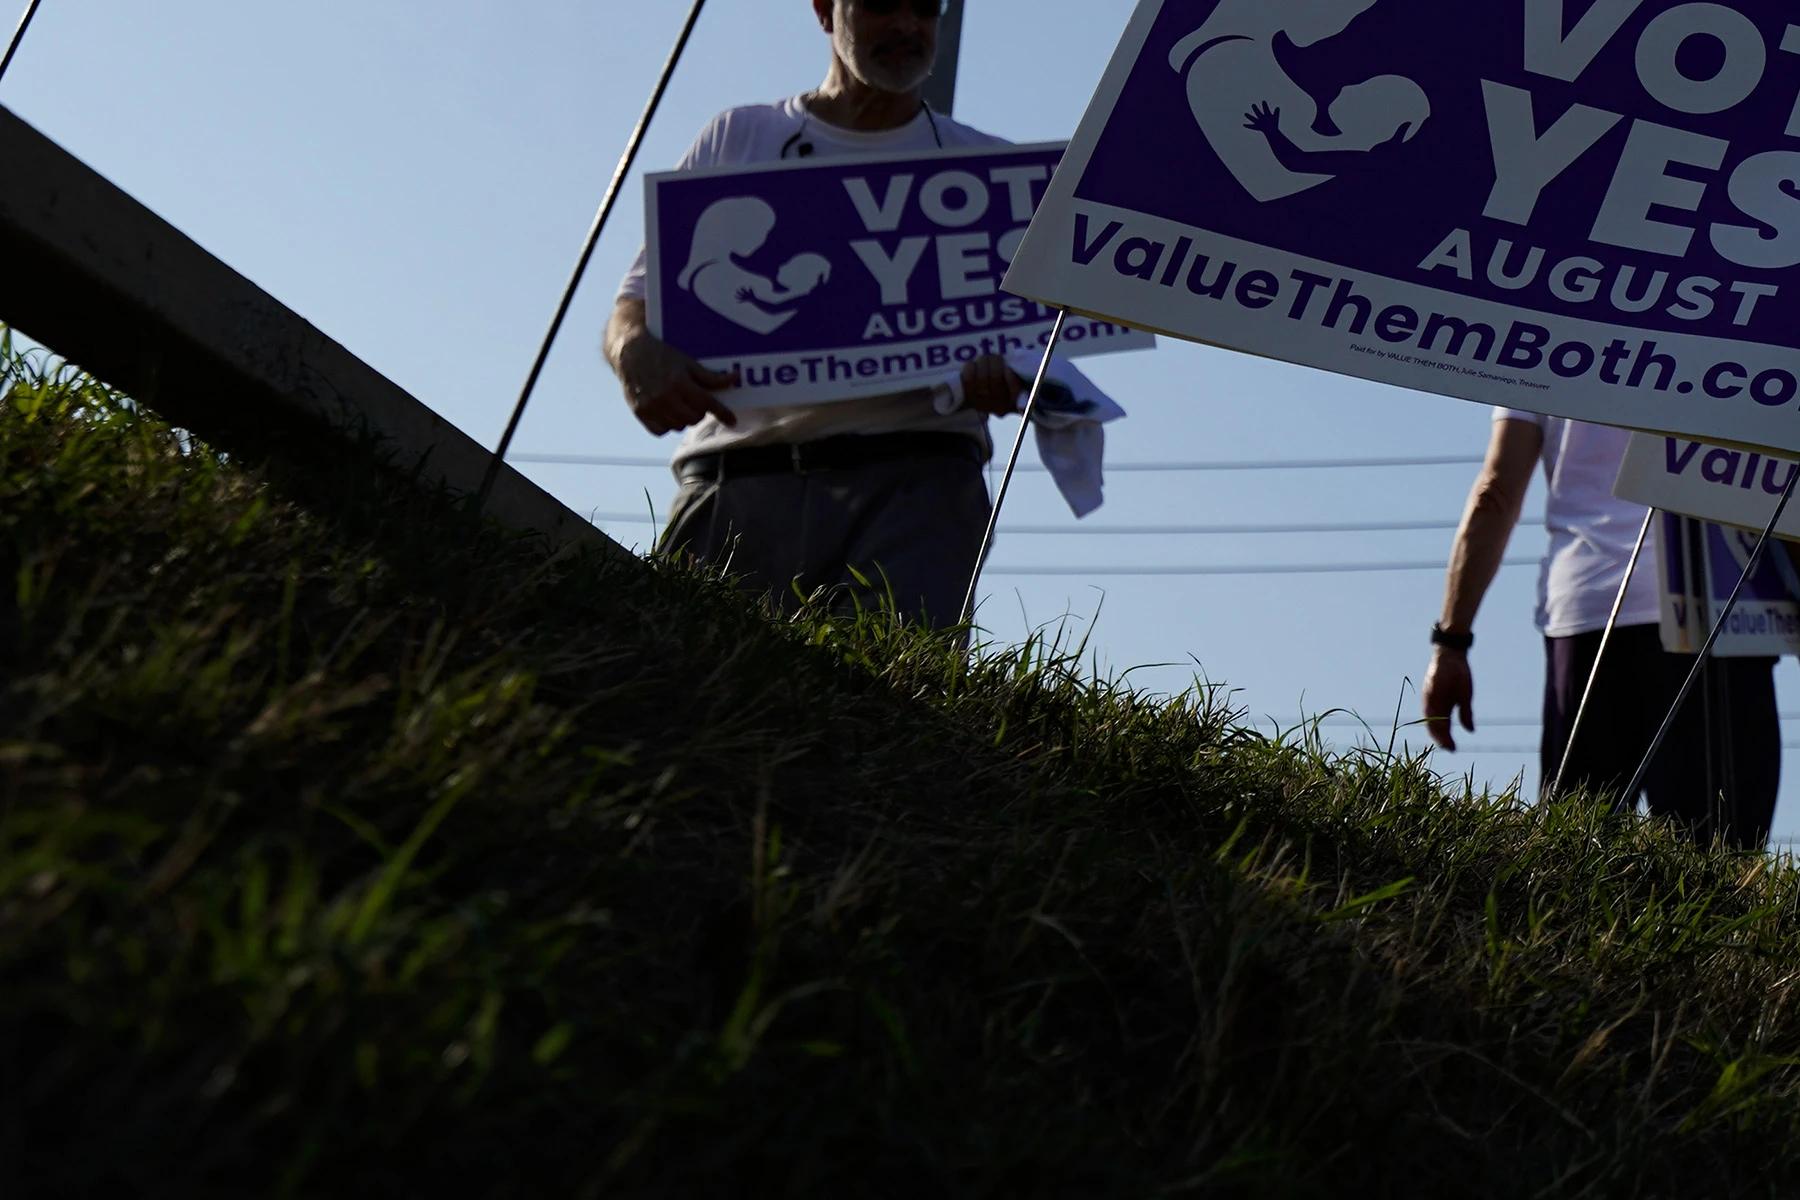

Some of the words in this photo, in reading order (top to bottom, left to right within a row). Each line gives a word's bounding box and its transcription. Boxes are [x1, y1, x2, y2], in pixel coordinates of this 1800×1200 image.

[842, 163, 1060, 233] VOT
[848, 226, 1028, 306] YE
[1417, 227, 1779, 327] AUGUST
[717, 318, 1130, 388] lueThemBoth.com
[1350, 343, 1366, 353] Paid
[1366, 347, 1376, 355] for
[1377, 350, 1386, 358] by
[1387, 352, 1413, 363] VALUE
[1413, 357, 1436, 368] THEM
